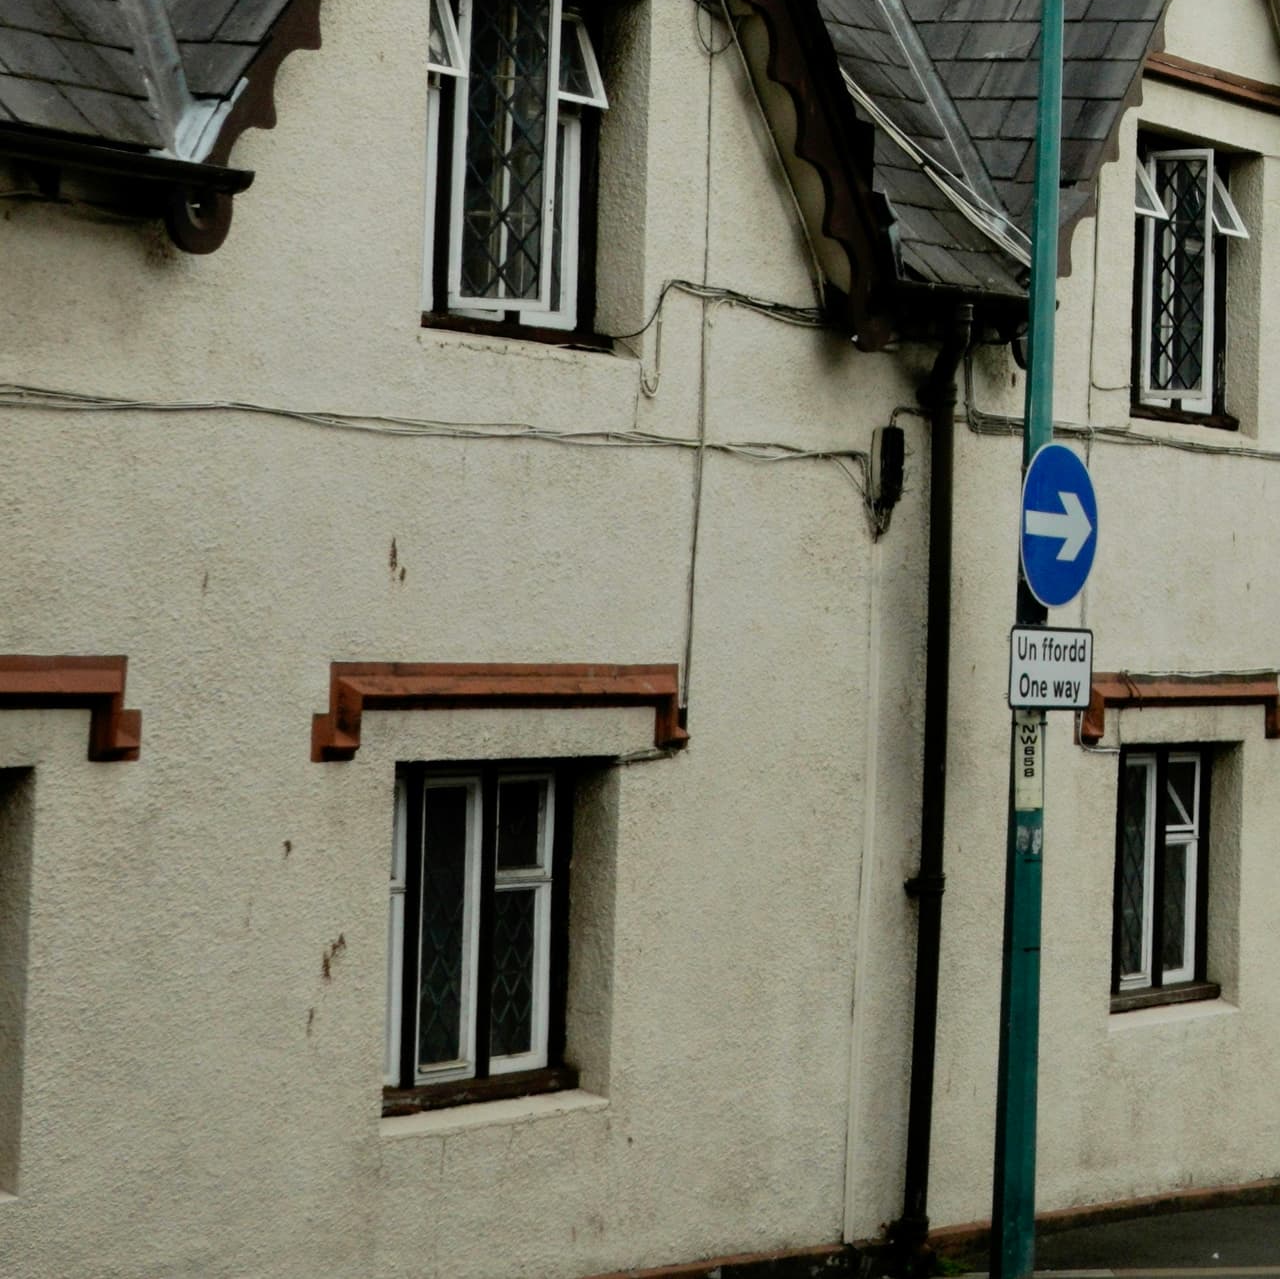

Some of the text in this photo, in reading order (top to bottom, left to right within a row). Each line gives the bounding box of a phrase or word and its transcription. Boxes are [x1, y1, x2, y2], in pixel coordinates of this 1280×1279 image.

[1017, 636, 1086, 662] Un ffordd
[1019, 672, 1081, 703] One way
